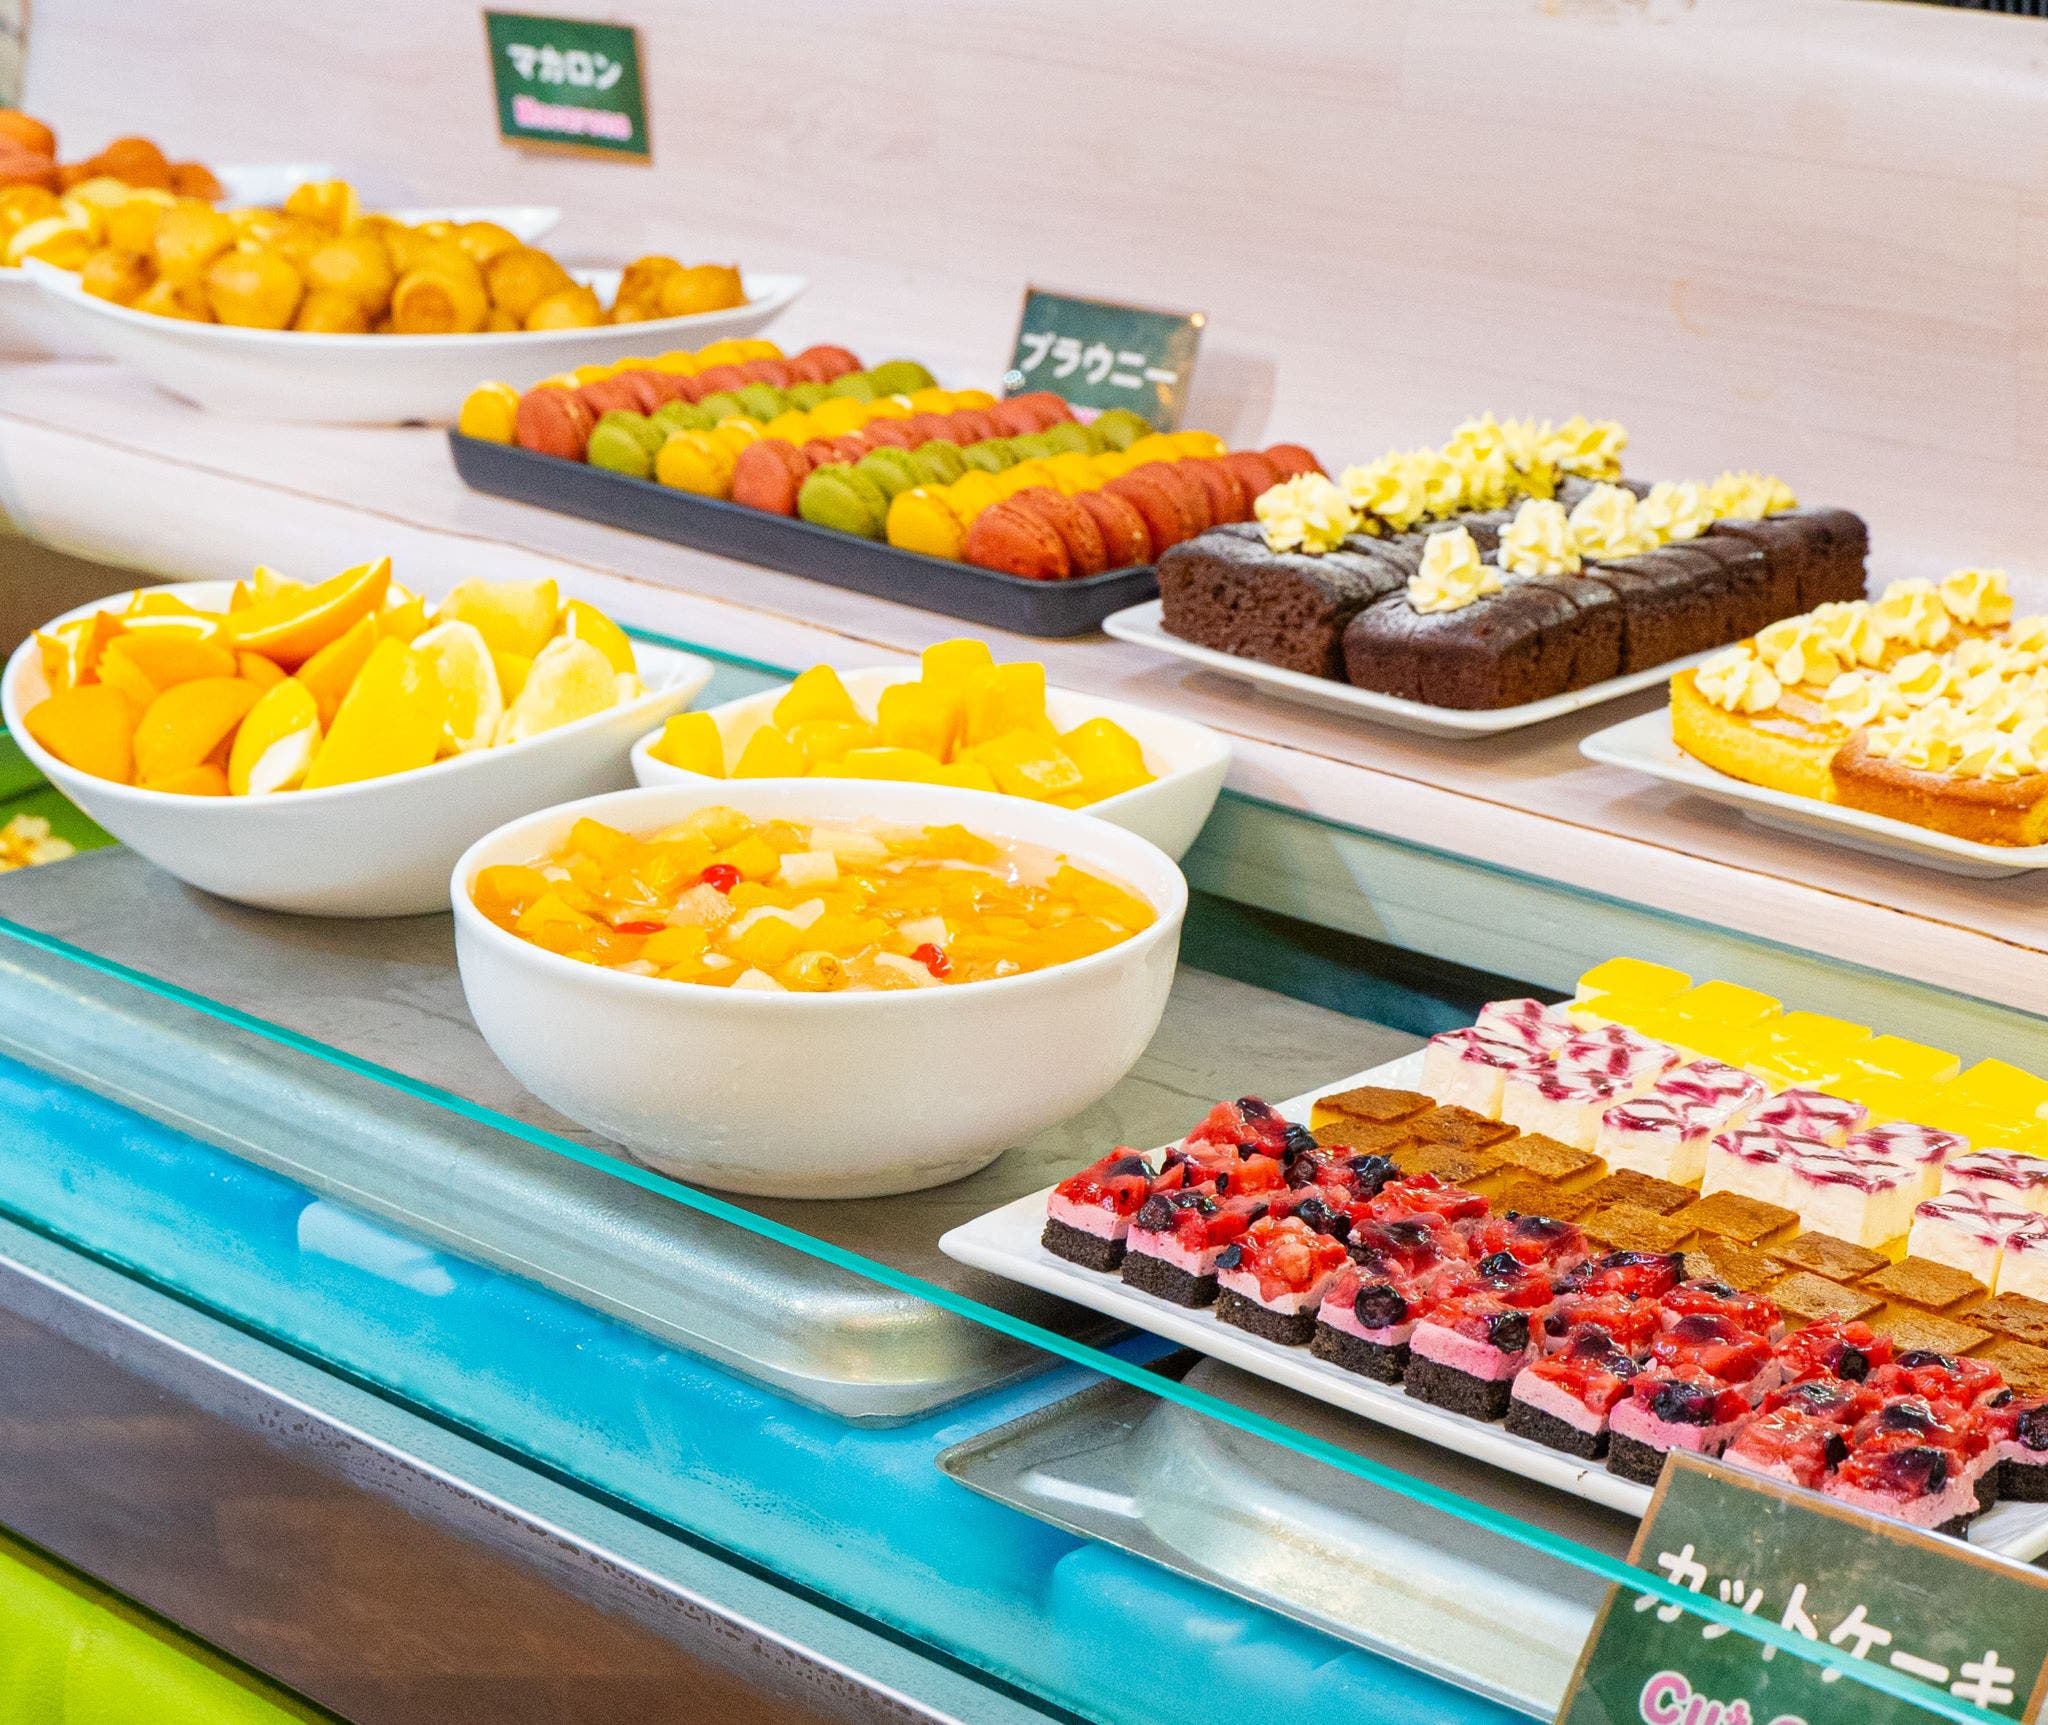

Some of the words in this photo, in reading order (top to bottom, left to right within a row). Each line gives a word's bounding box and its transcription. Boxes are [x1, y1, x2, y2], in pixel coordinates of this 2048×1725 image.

[506, 45, 622, 90] マカロン
[1018, 331, 1178, 390] ブラウニー
[1633, 1543, 2016, 1709] カットケーキ
